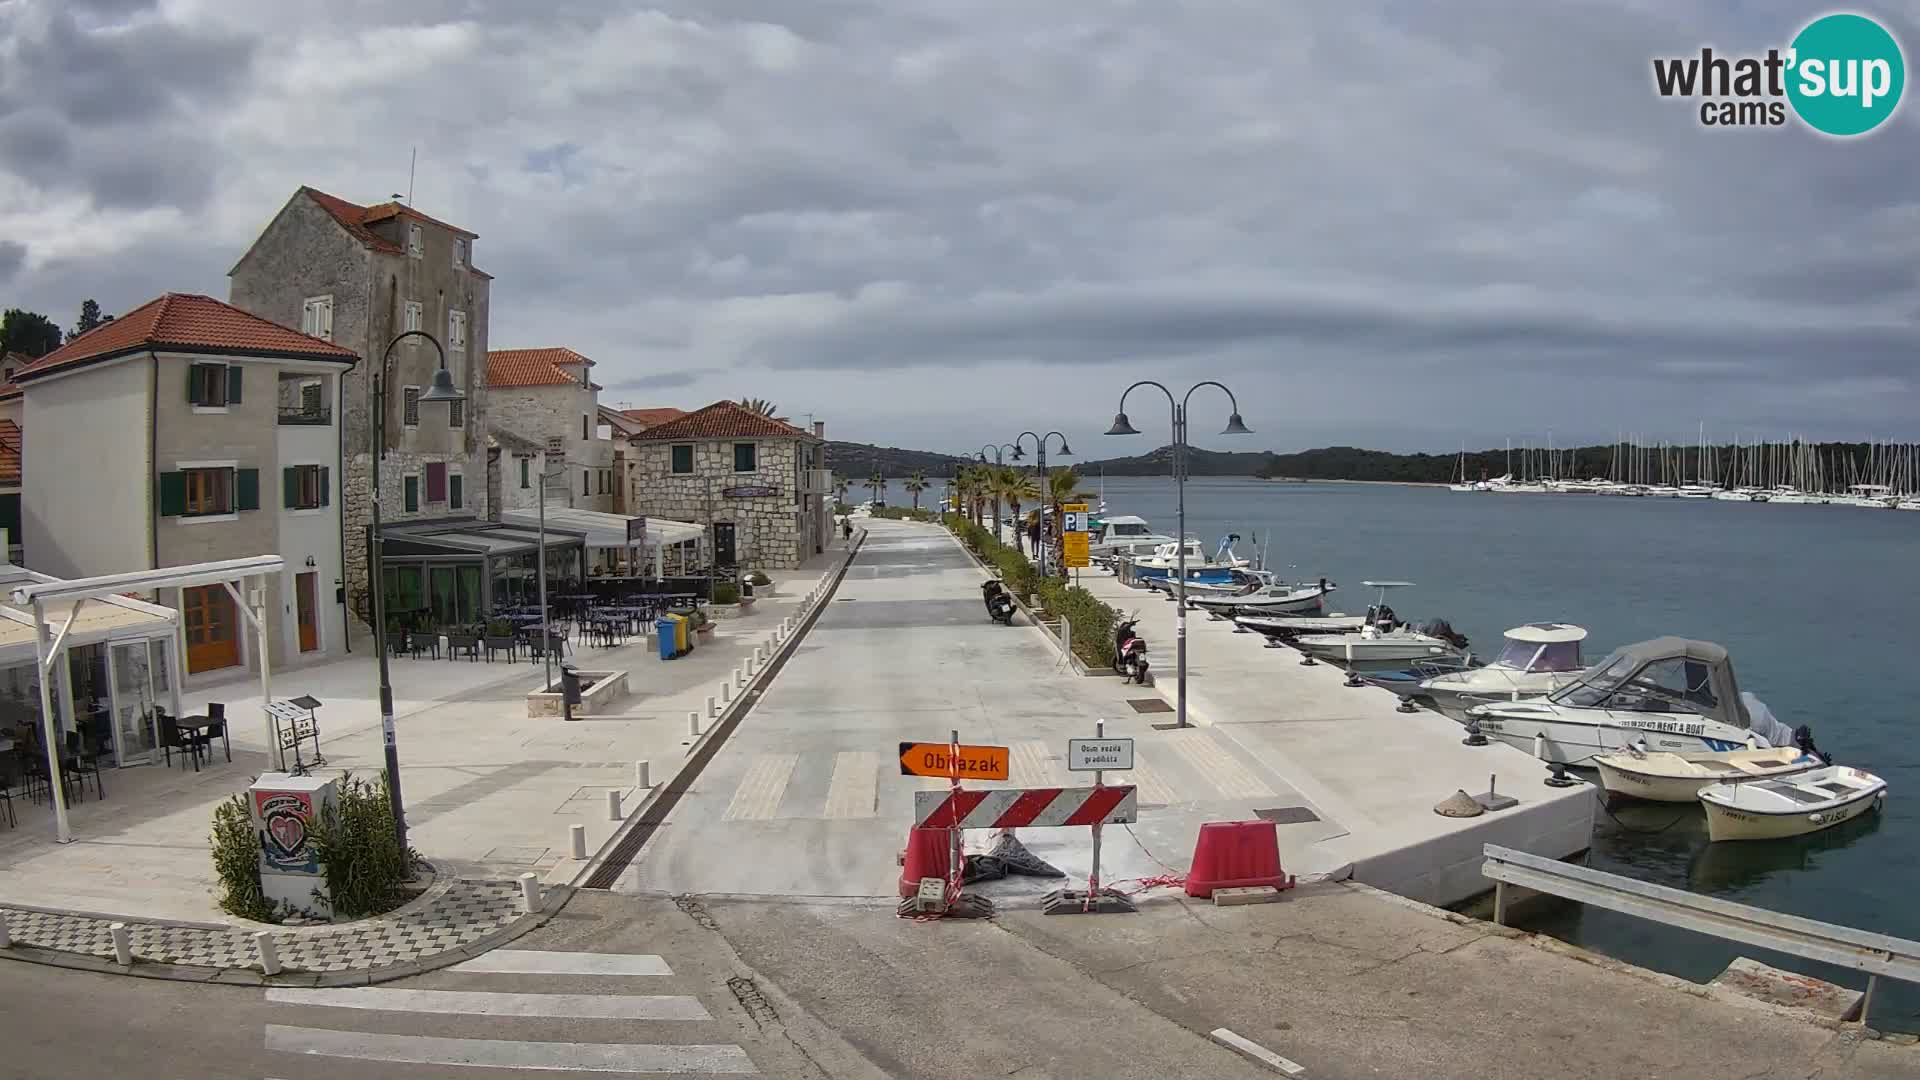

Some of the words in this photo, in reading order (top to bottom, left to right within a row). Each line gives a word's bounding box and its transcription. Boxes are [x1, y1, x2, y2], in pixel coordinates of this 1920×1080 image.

[1065, 514, 1076, 530] P
[1657, 721, 1678, 732] RENT
[1678, 723, 1684, 732] A
[1686, 724, 1706, 735] BOAT
